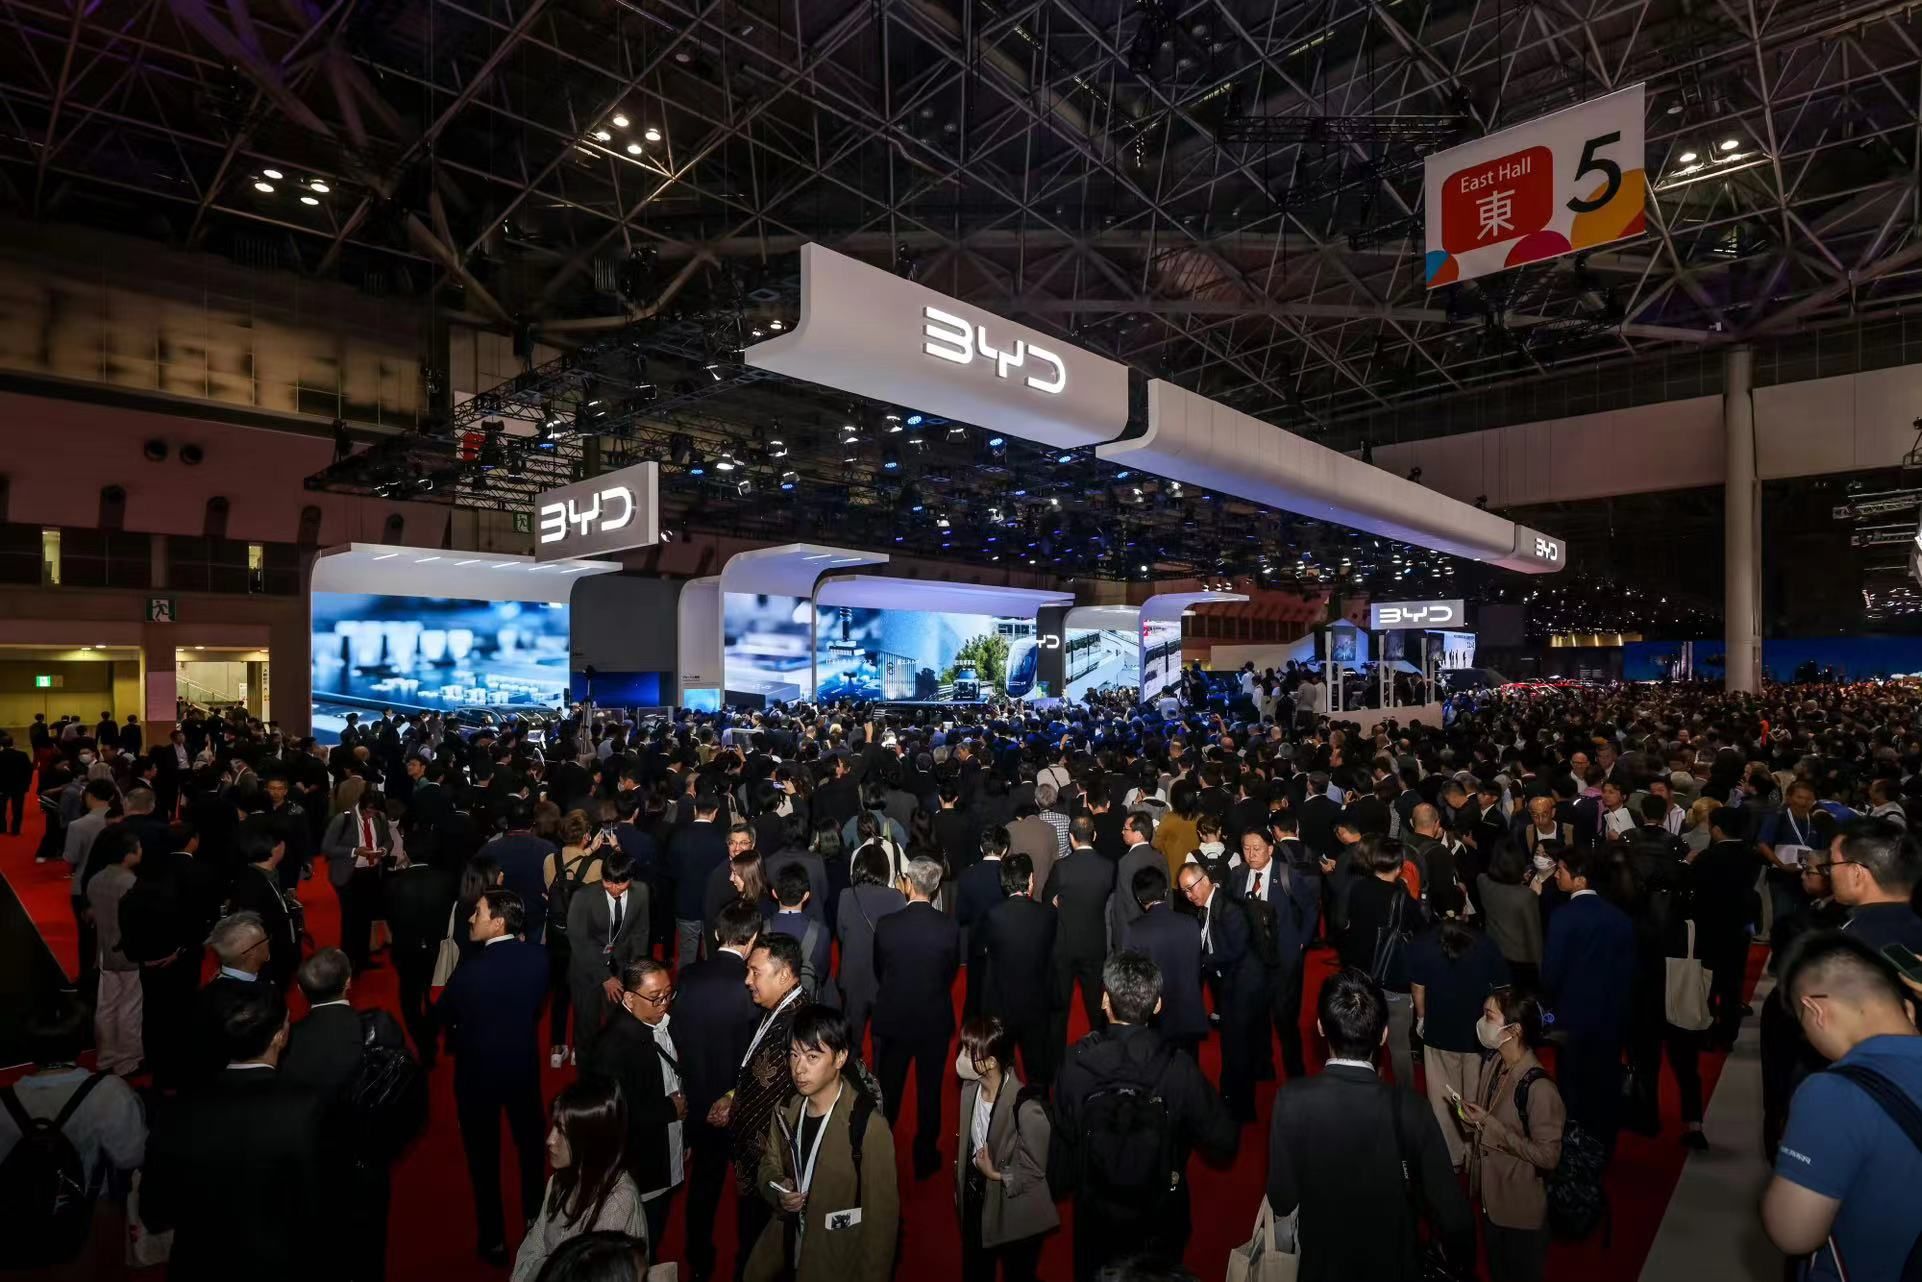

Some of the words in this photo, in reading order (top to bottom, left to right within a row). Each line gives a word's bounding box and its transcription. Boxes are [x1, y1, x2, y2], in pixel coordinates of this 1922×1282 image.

[1461, 171, 1494, 194] East
[1499, 156, 1531, 182] Hall
[1566, 130, 1622, 213] 5
[1475, 189, 1516, 240] 東
[924, 306, 1066, 394] BYD
[541, 486, 633, 544] BYD
[1536, 537, 1558, 561] BYD
[1379, 605, 1453, 624] BYD
[1036, 634, 1060, 649] YD
